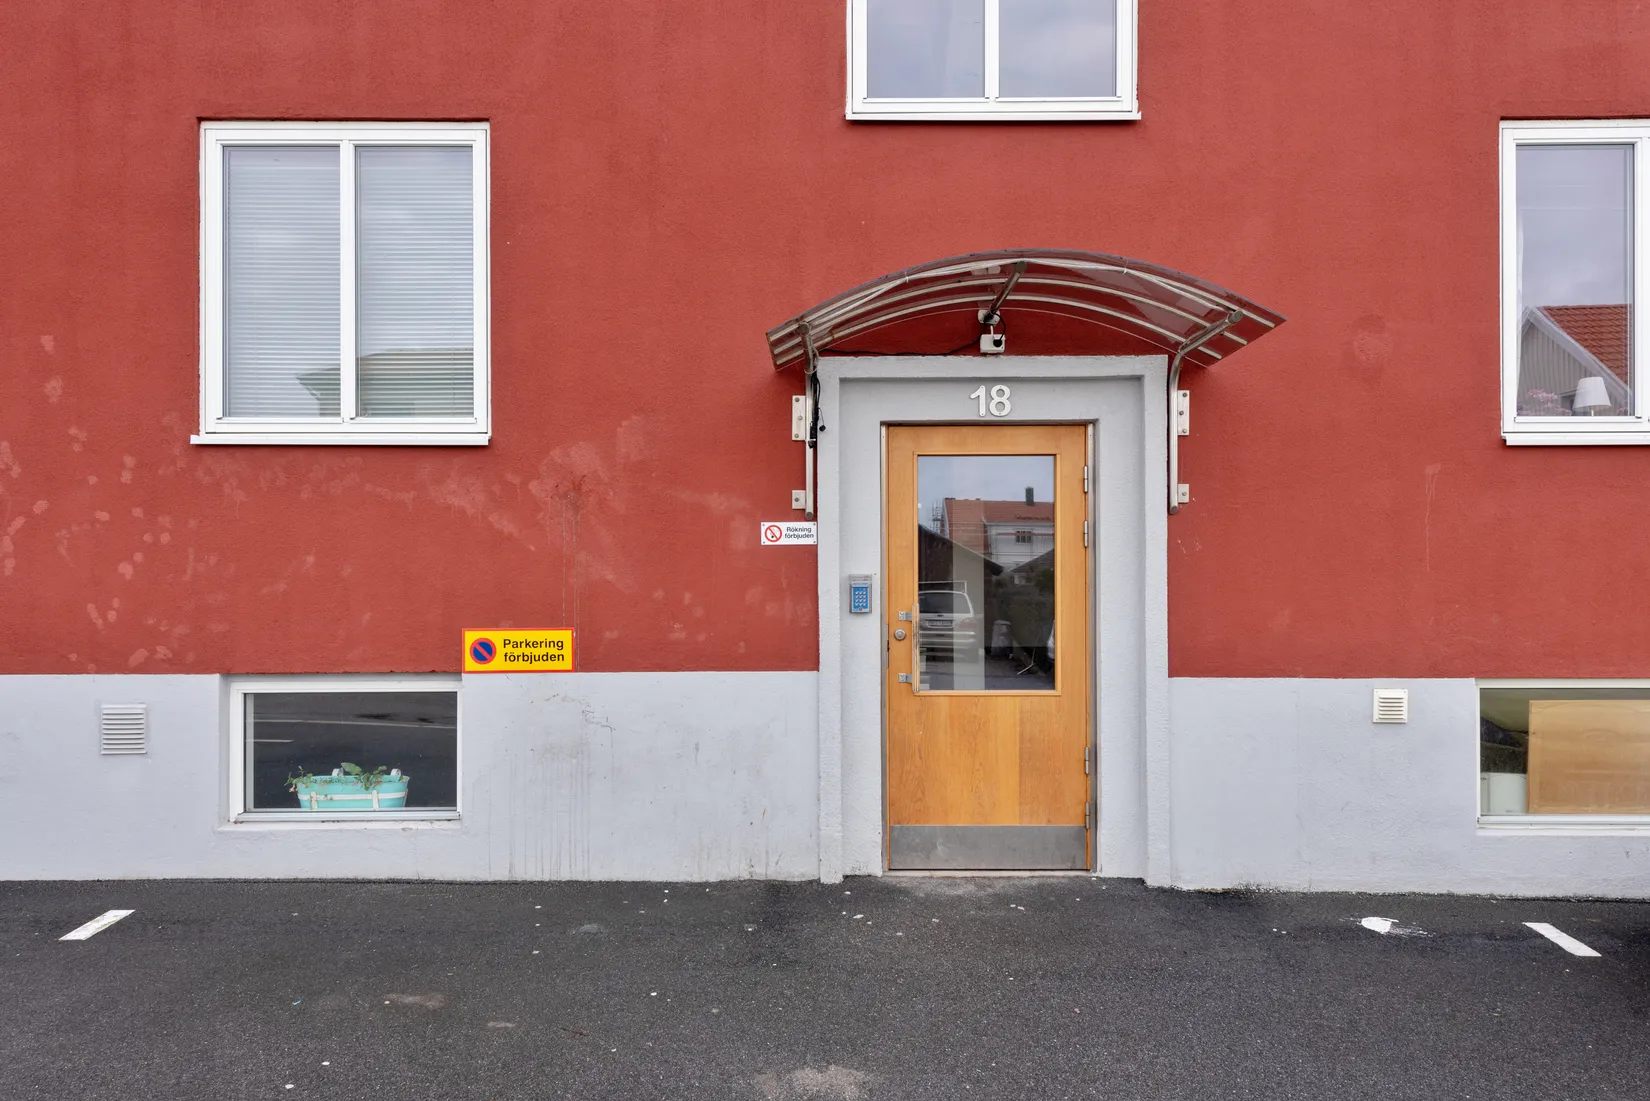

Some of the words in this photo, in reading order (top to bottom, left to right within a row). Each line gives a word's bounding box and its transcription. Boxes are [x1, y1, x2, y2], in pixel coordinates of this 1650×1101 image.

[970, 385, 1011, 417] 18
[503, 638, 564, 650] Parkering
[504, 652, 564, 664] förbjuden
